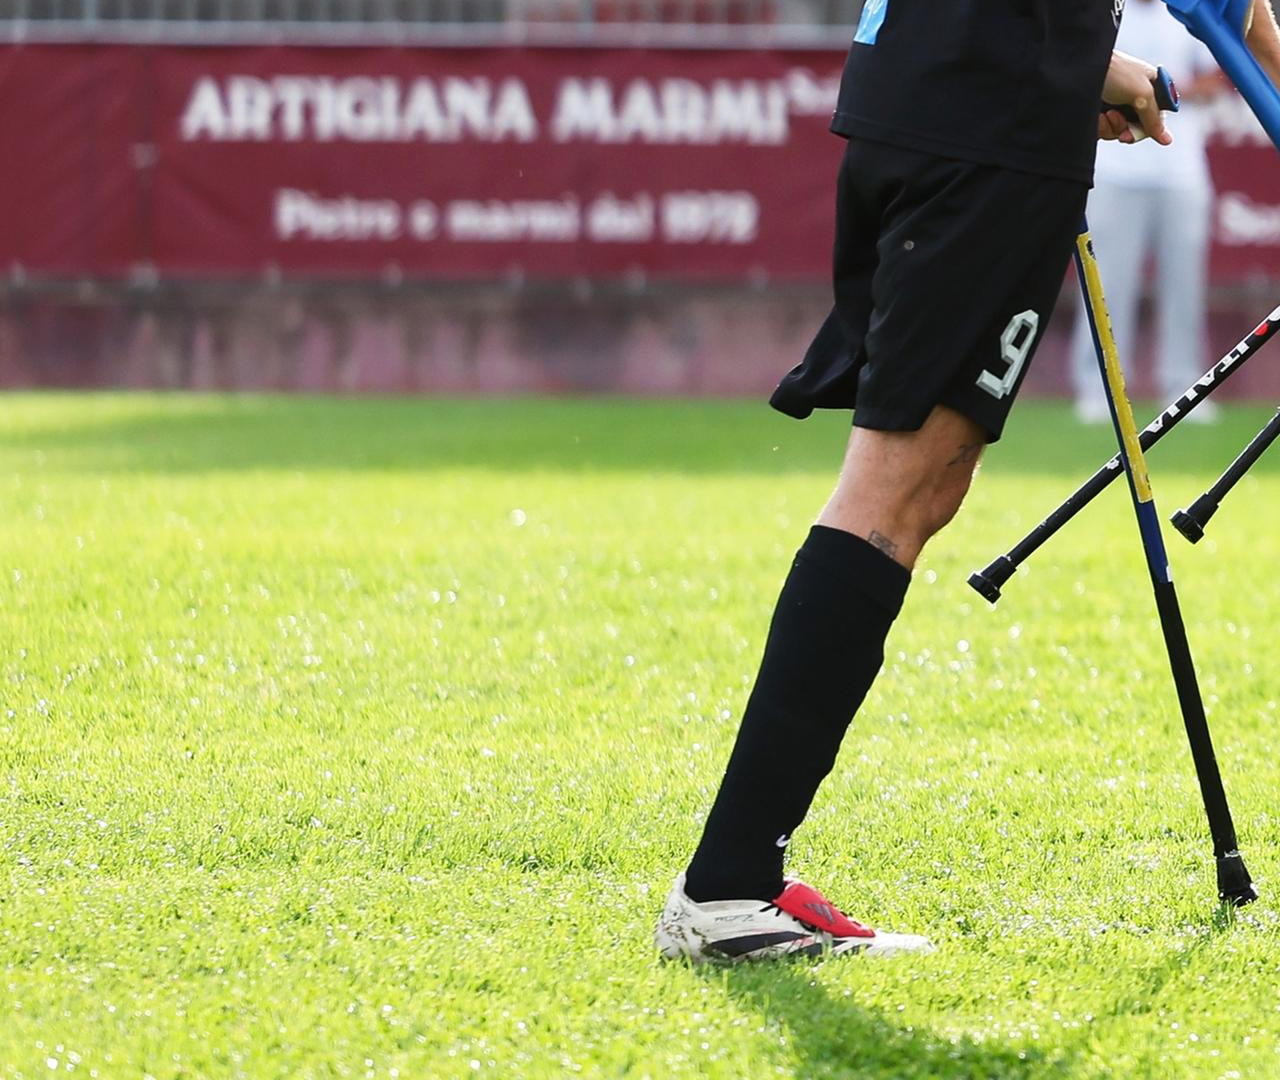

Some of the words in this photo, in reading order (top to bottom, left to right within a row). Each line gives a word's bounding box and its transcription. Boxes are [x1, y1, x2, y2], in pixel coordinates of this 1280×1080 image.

[183, 73, 538, 141] ARTIGIANA
[551, 75, 790, 146] MARMI
[975, 308, 1039, 400] 9
